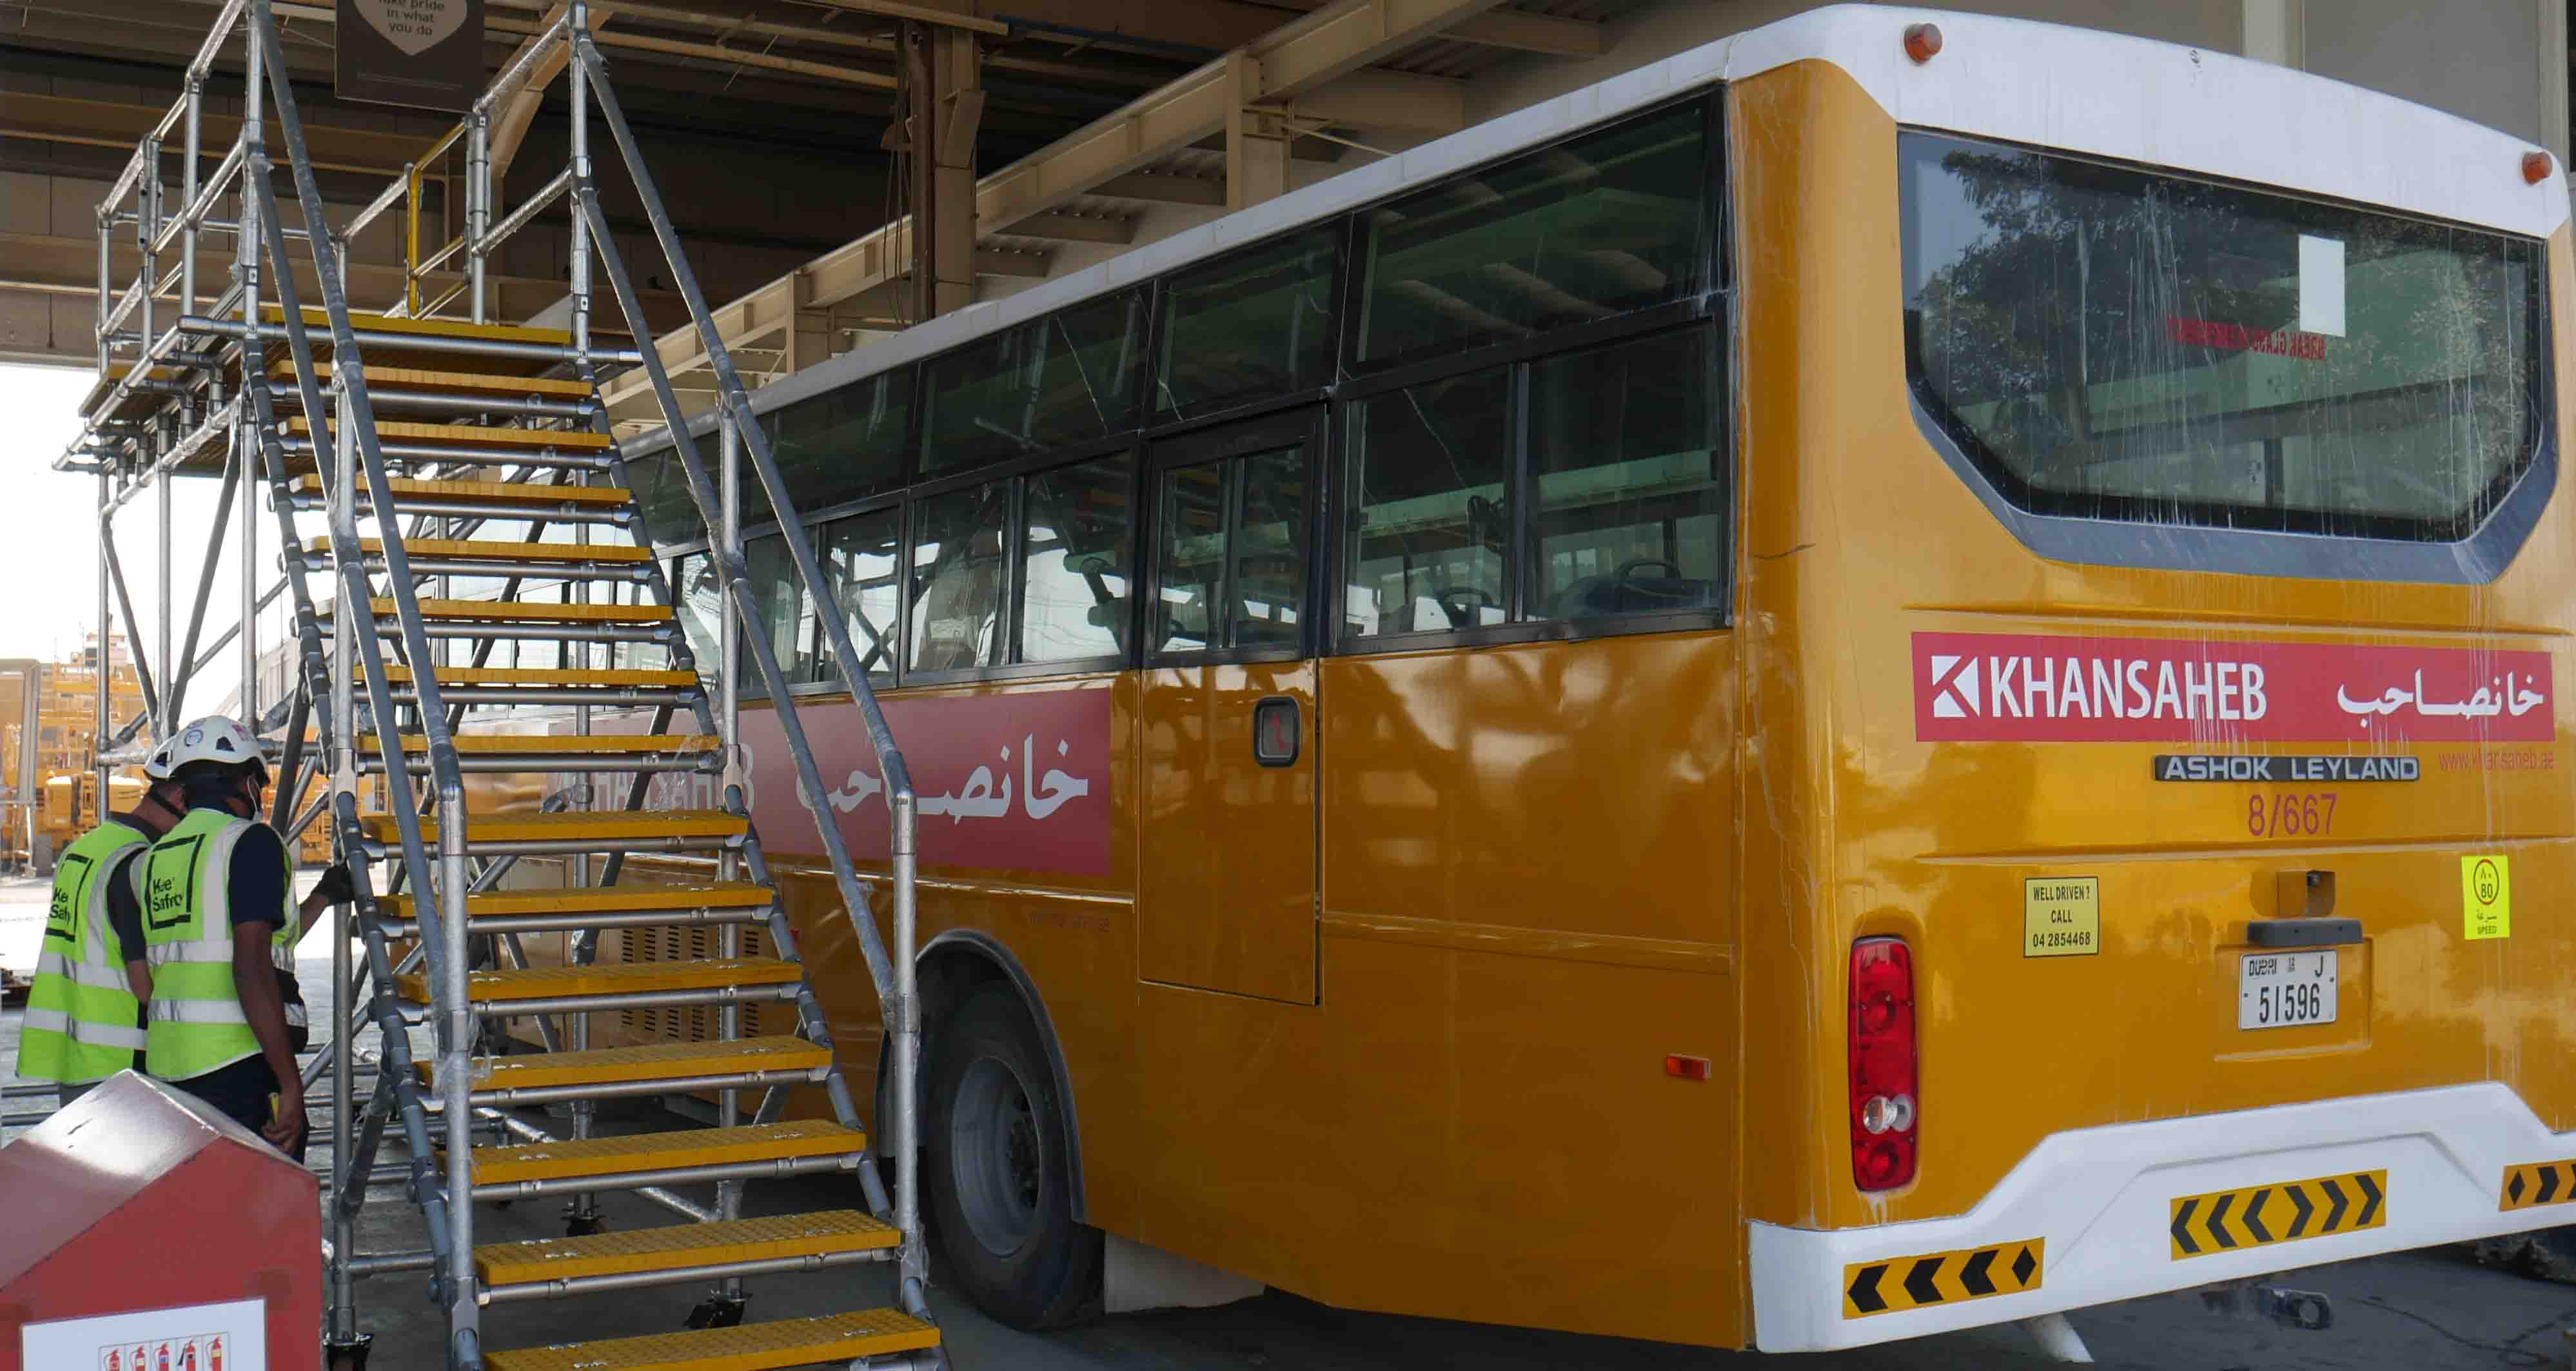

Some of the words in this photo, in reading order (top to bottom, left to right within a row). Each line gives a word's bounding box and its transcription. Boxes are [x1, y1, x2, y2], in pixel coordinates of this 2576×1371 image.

[387, 10, 398, 19] in
[403, 10, 433, 22] what
[389, 23, 413, 34] you
[417, 25, 433, 36] do
[1990, 656, 2267, 720] KHANSAHEB
[2165, 756, 2272, 780] ASHOK
[2291, 757, 2419, 780] LEYLAND
[2248, 793, 2338, 838] 8/667
[2034, 887, 2054, 901] WELL
[2056, 885, 2084, 900] DRIVEN
[2481, 883, 2493, 898] 80
[2051, 909, 2072, 923] CALL
[2477, 925, 2497, 934] SPEED
[2032, 933, 2045, 947] 04
[2048, 931, 2090, 947] 2854468
[2314, 955, 2324, 978] J
[2259, 983, 2320, 1023] 51596
